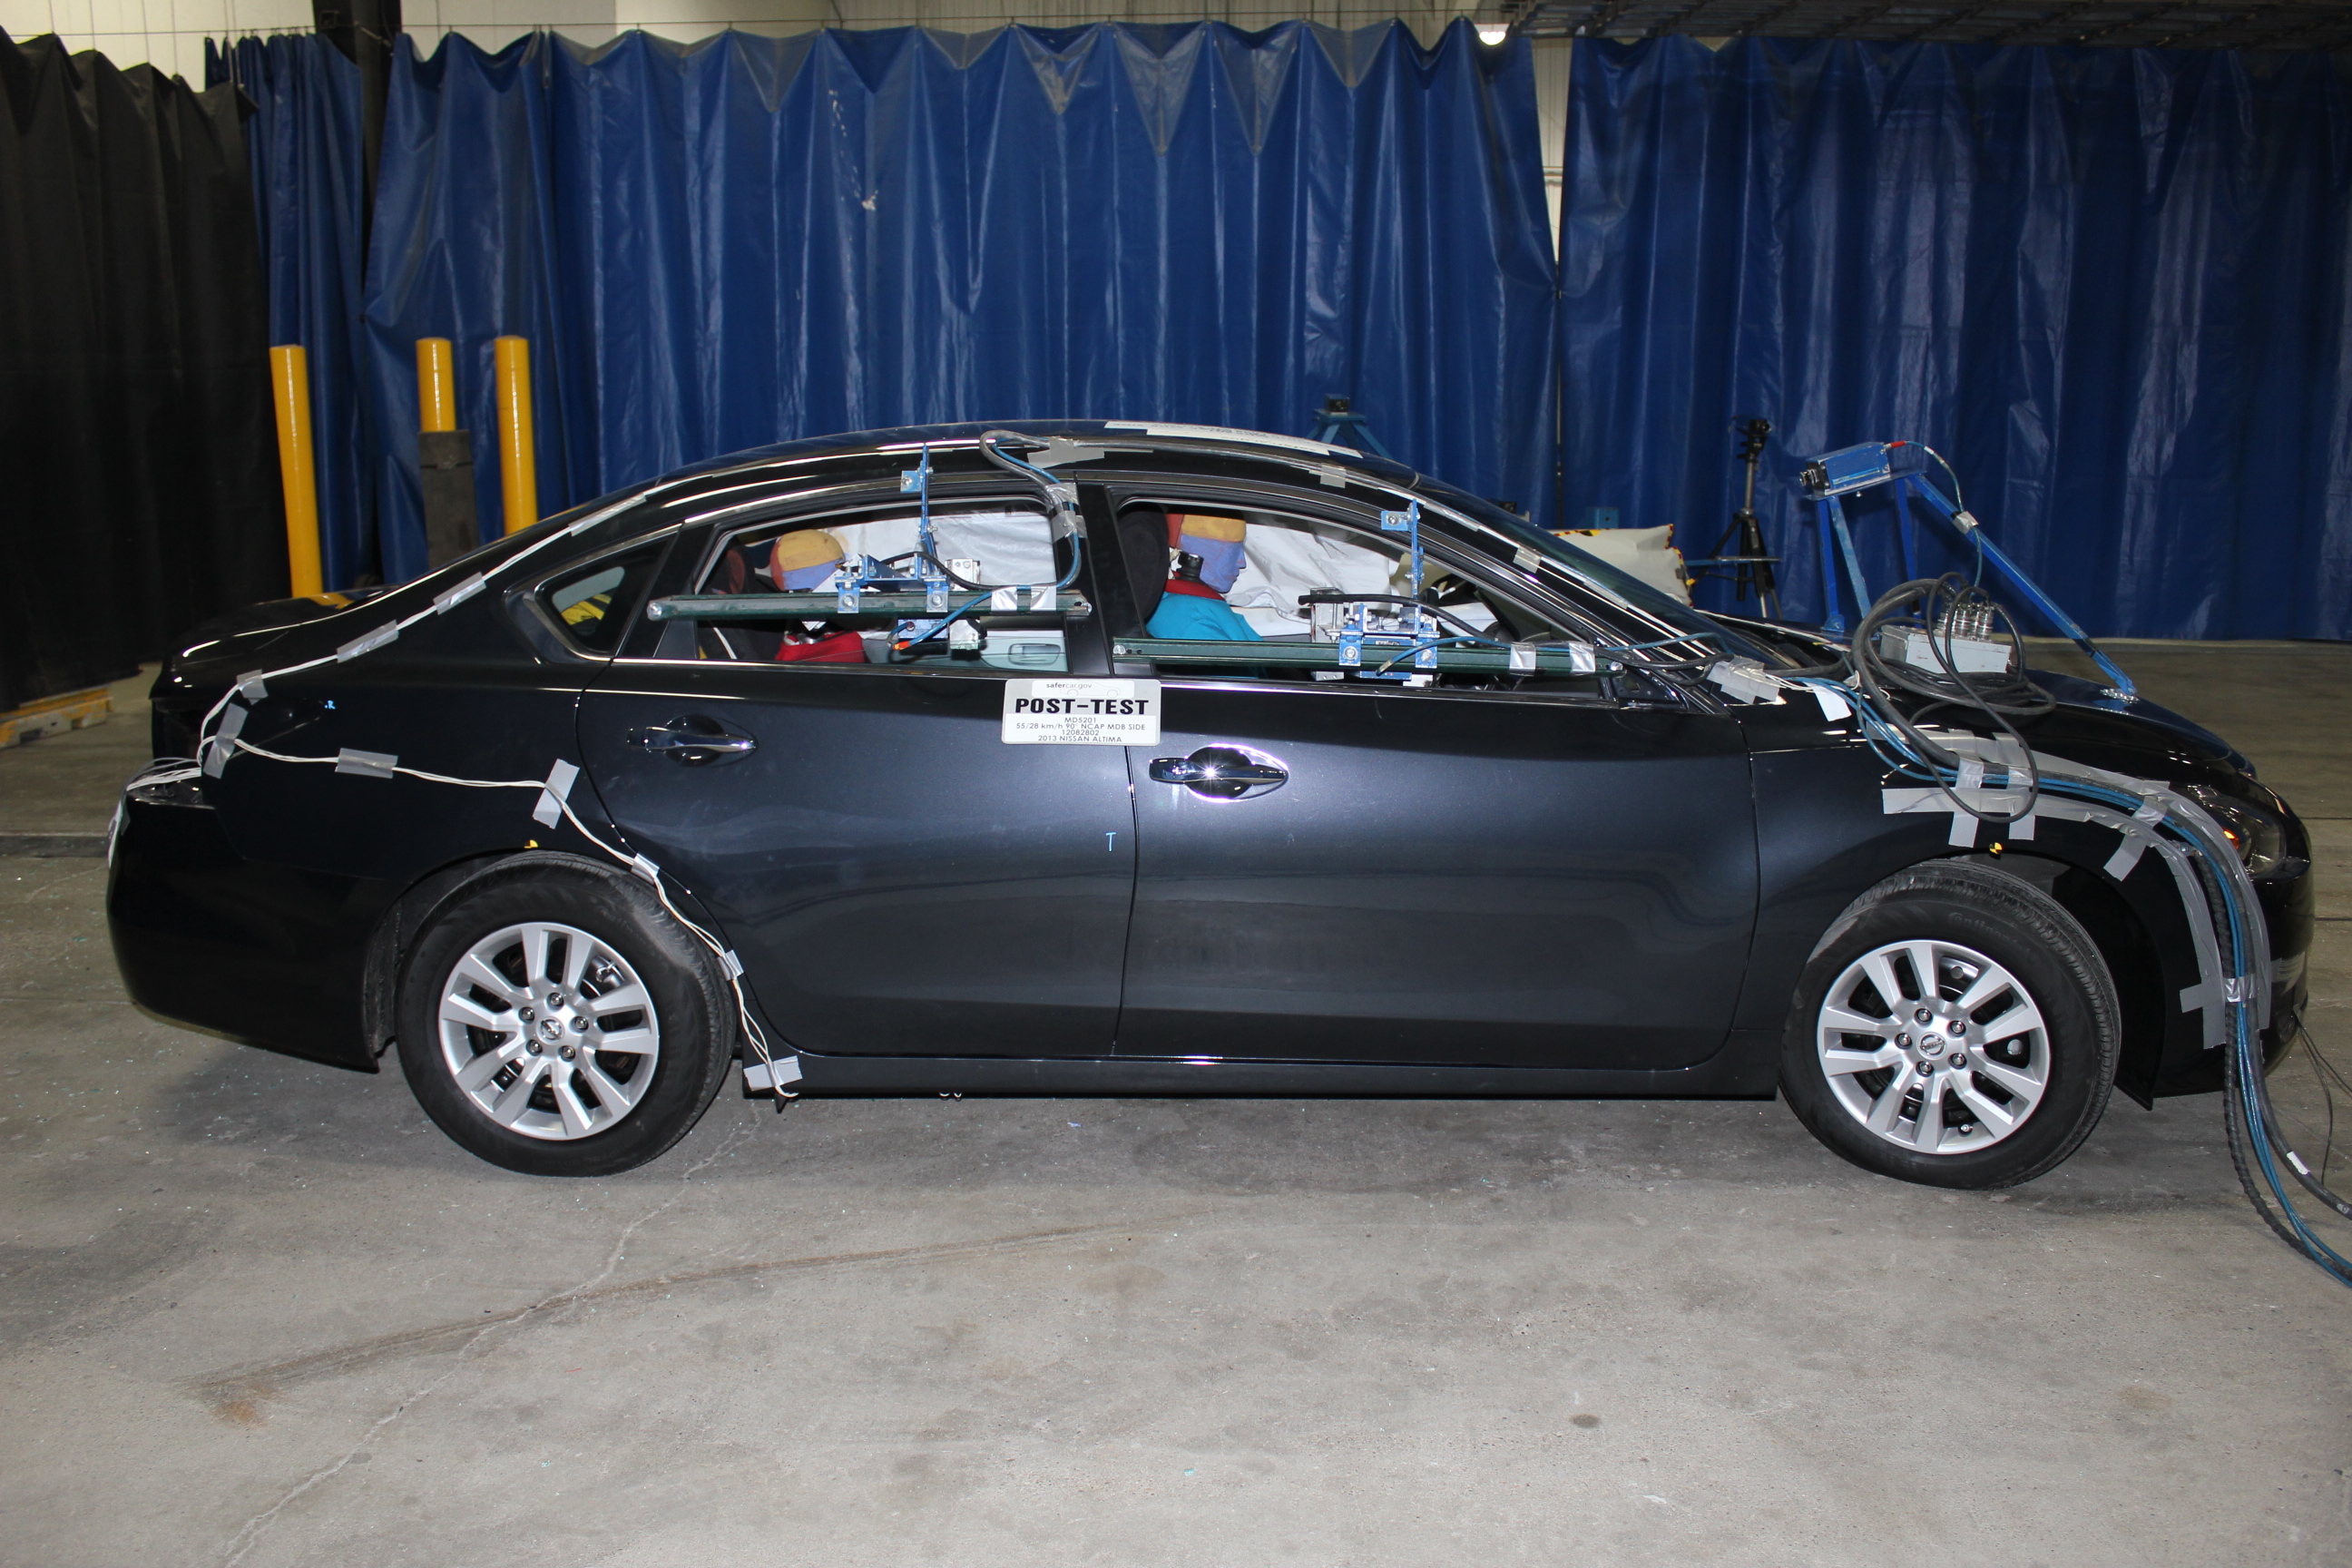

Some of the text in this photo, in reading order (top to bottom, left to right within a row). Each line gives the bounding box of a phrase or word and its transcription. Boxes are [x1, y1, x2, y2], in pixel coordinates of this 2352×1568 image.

[1046, 681, 1093, 690] safercar.gov
[1014, 698, 1149, 715] POST-TEST
[1105, 831, 1117, 852] T
